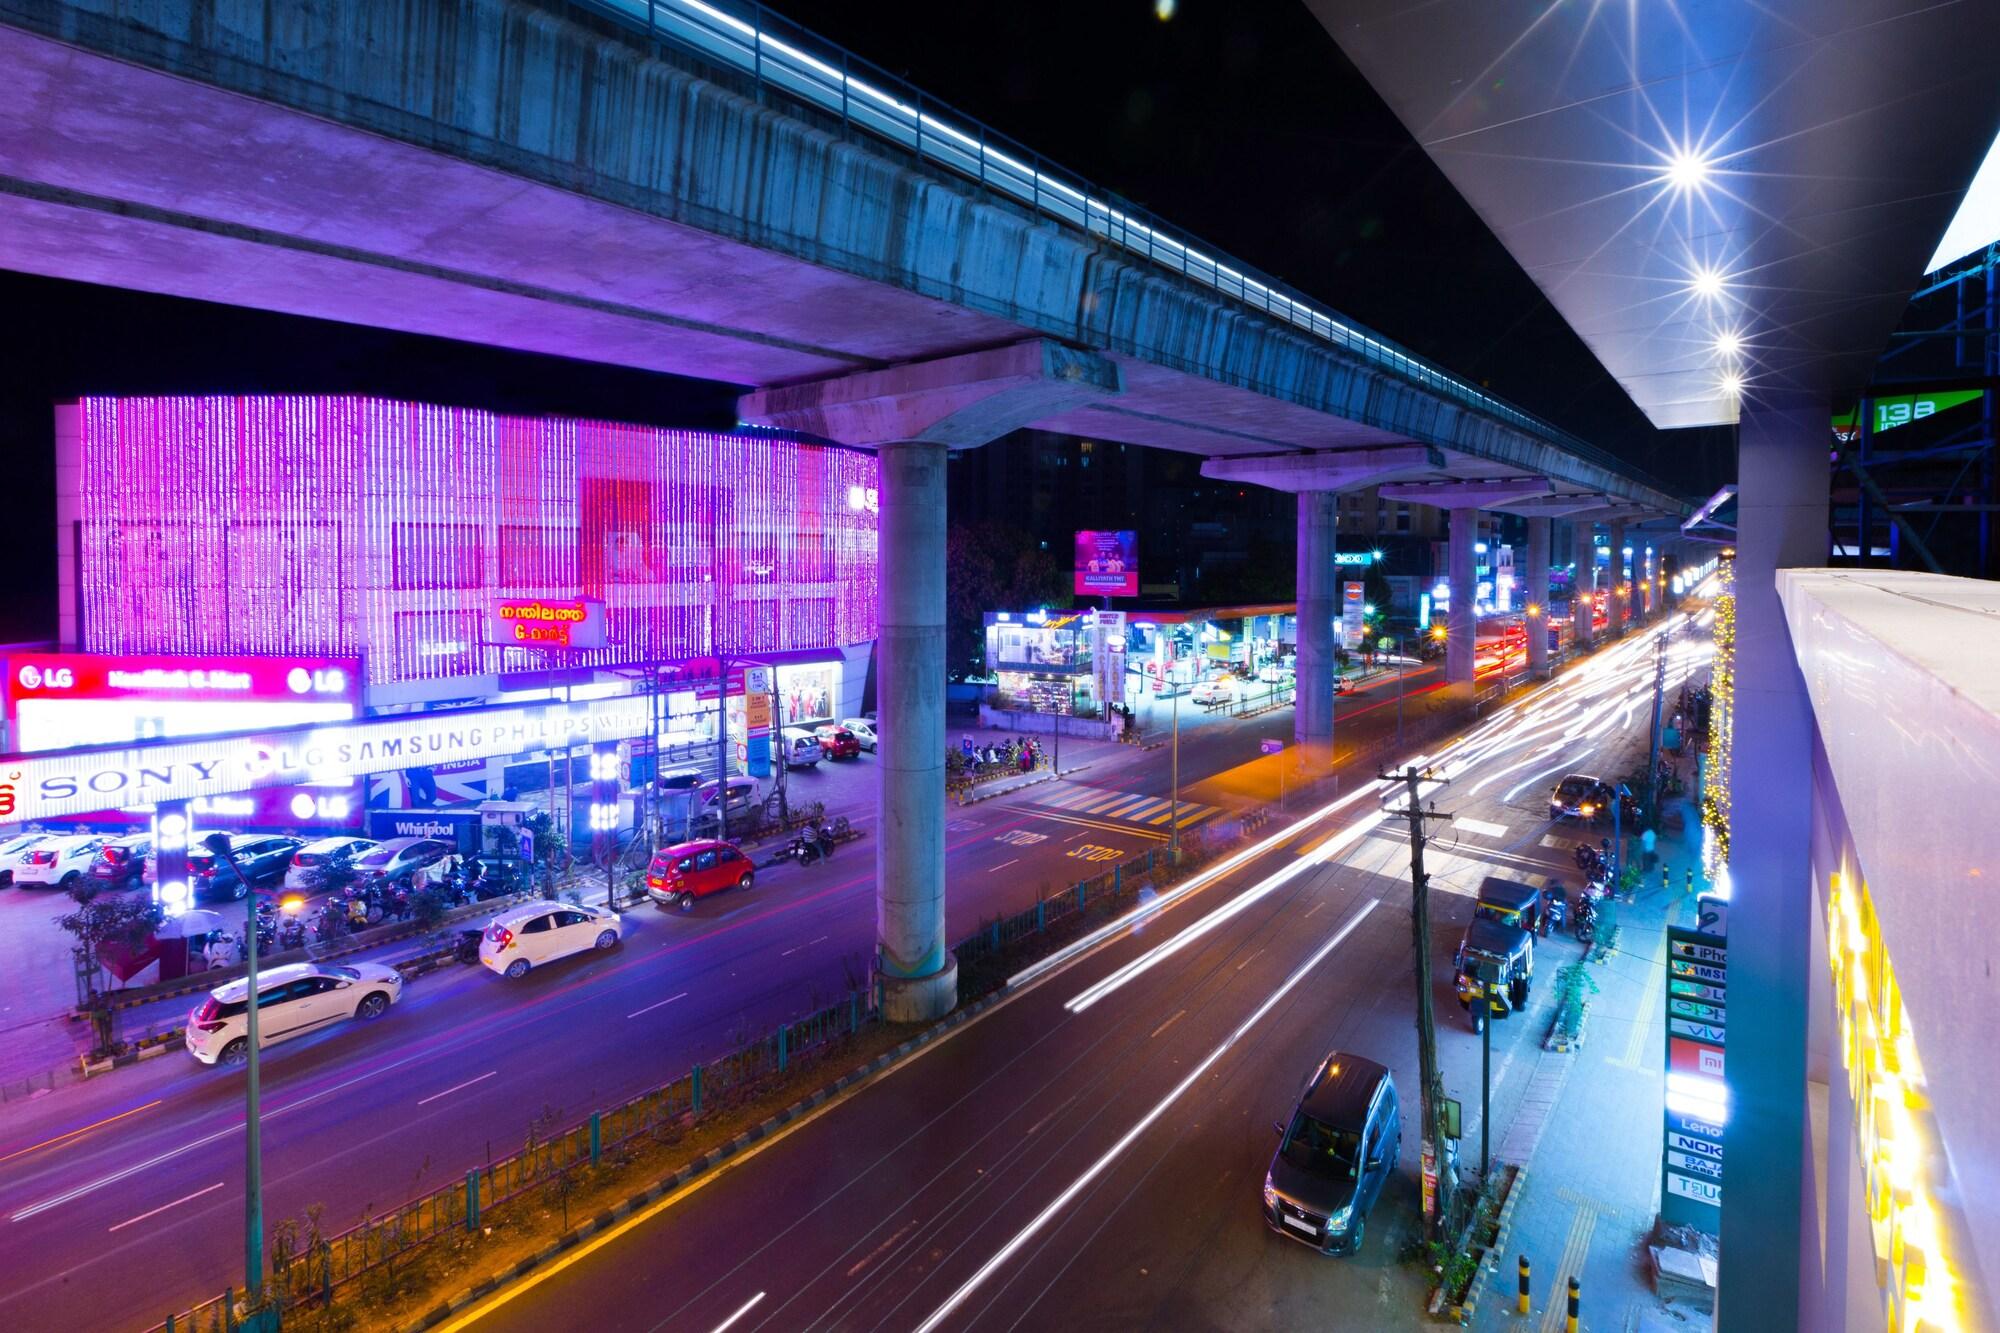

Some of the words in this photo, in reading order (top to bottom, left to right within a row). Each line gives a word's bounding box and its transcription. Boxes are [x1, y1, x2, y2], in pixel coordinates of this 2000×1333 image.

[44, 668, 73, 688] LG
[313, 670, 346, 693] LG
[39, 758, 225, 801] SONY
[338, 728, 482, 763] SAMSUNG
[493, 718, 590, 744] PHILIPS
[442, 759, 480, 770] INDIA
[317, 797, 350, 818] LG
[395, 821, 454, 839] Whirlpool
[993, 830, 1049, 846] STOP
[1066, 844, 1125, 862] STOP
